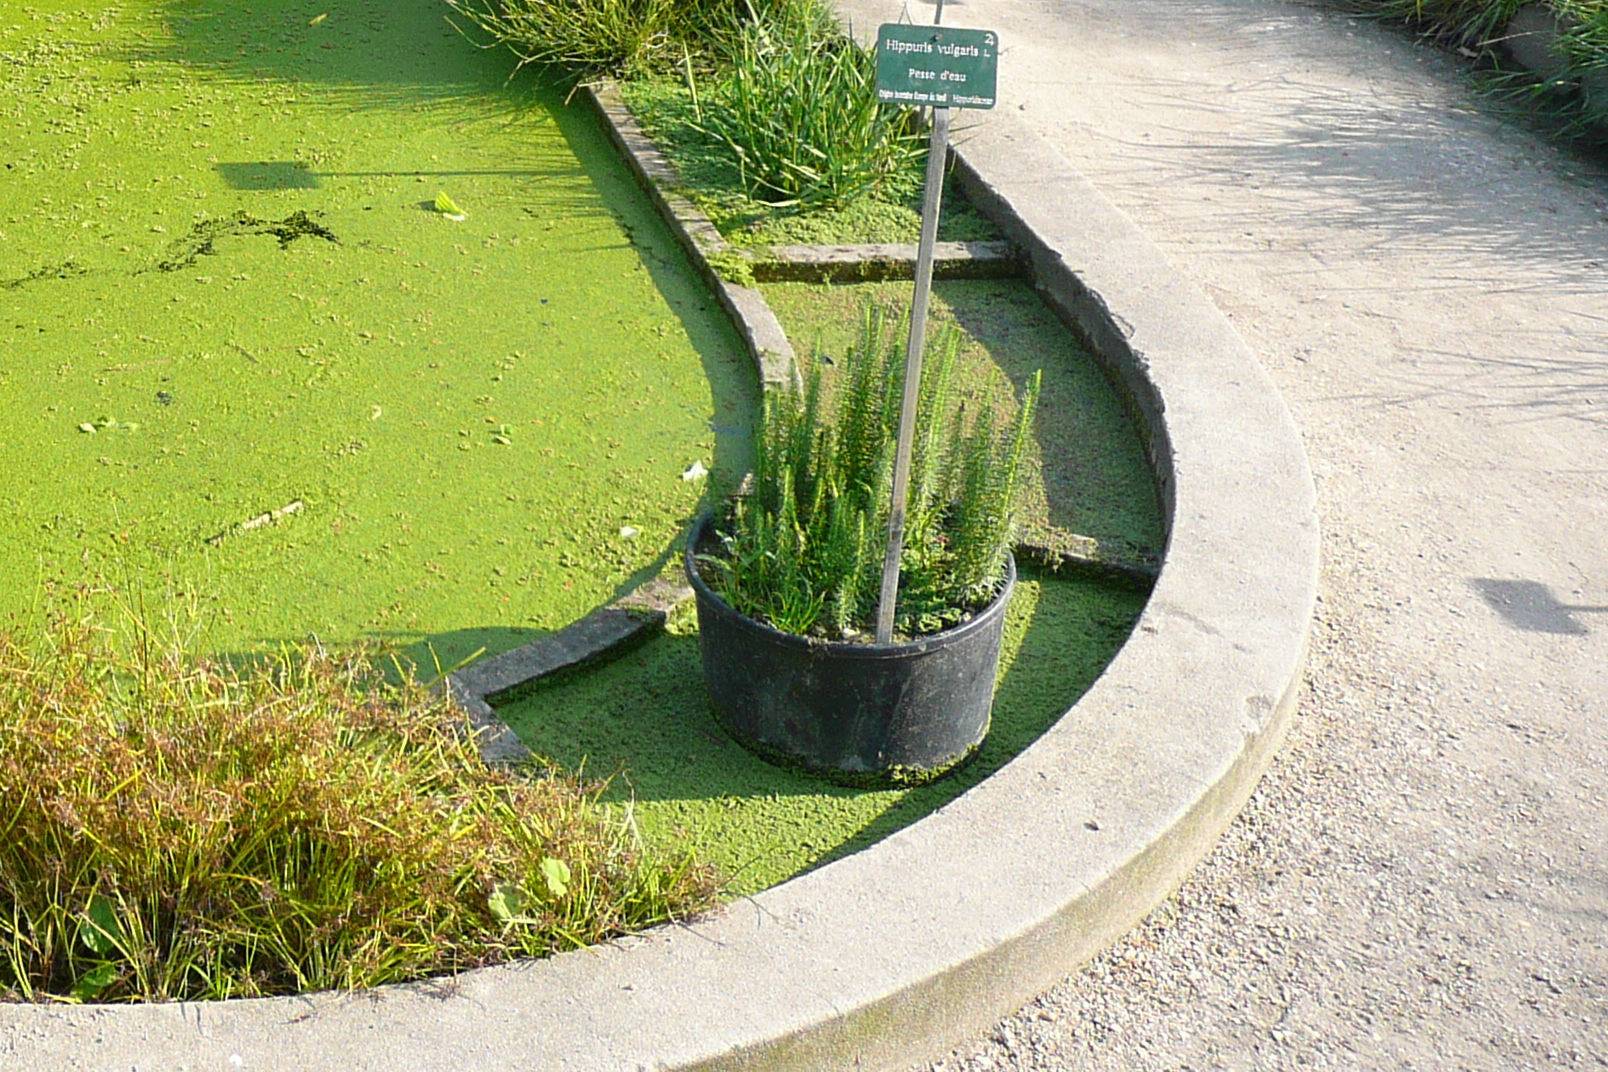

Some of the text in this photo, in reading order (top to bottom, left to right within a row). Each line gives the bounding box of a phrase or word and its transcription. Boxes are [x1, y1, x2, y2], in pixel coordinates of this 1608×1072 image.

[886, 39, 933, 54] Hippuris
[938, 43, 979, 58] vulgaris
[909, 68, 967, 82] Pesse d'eau
